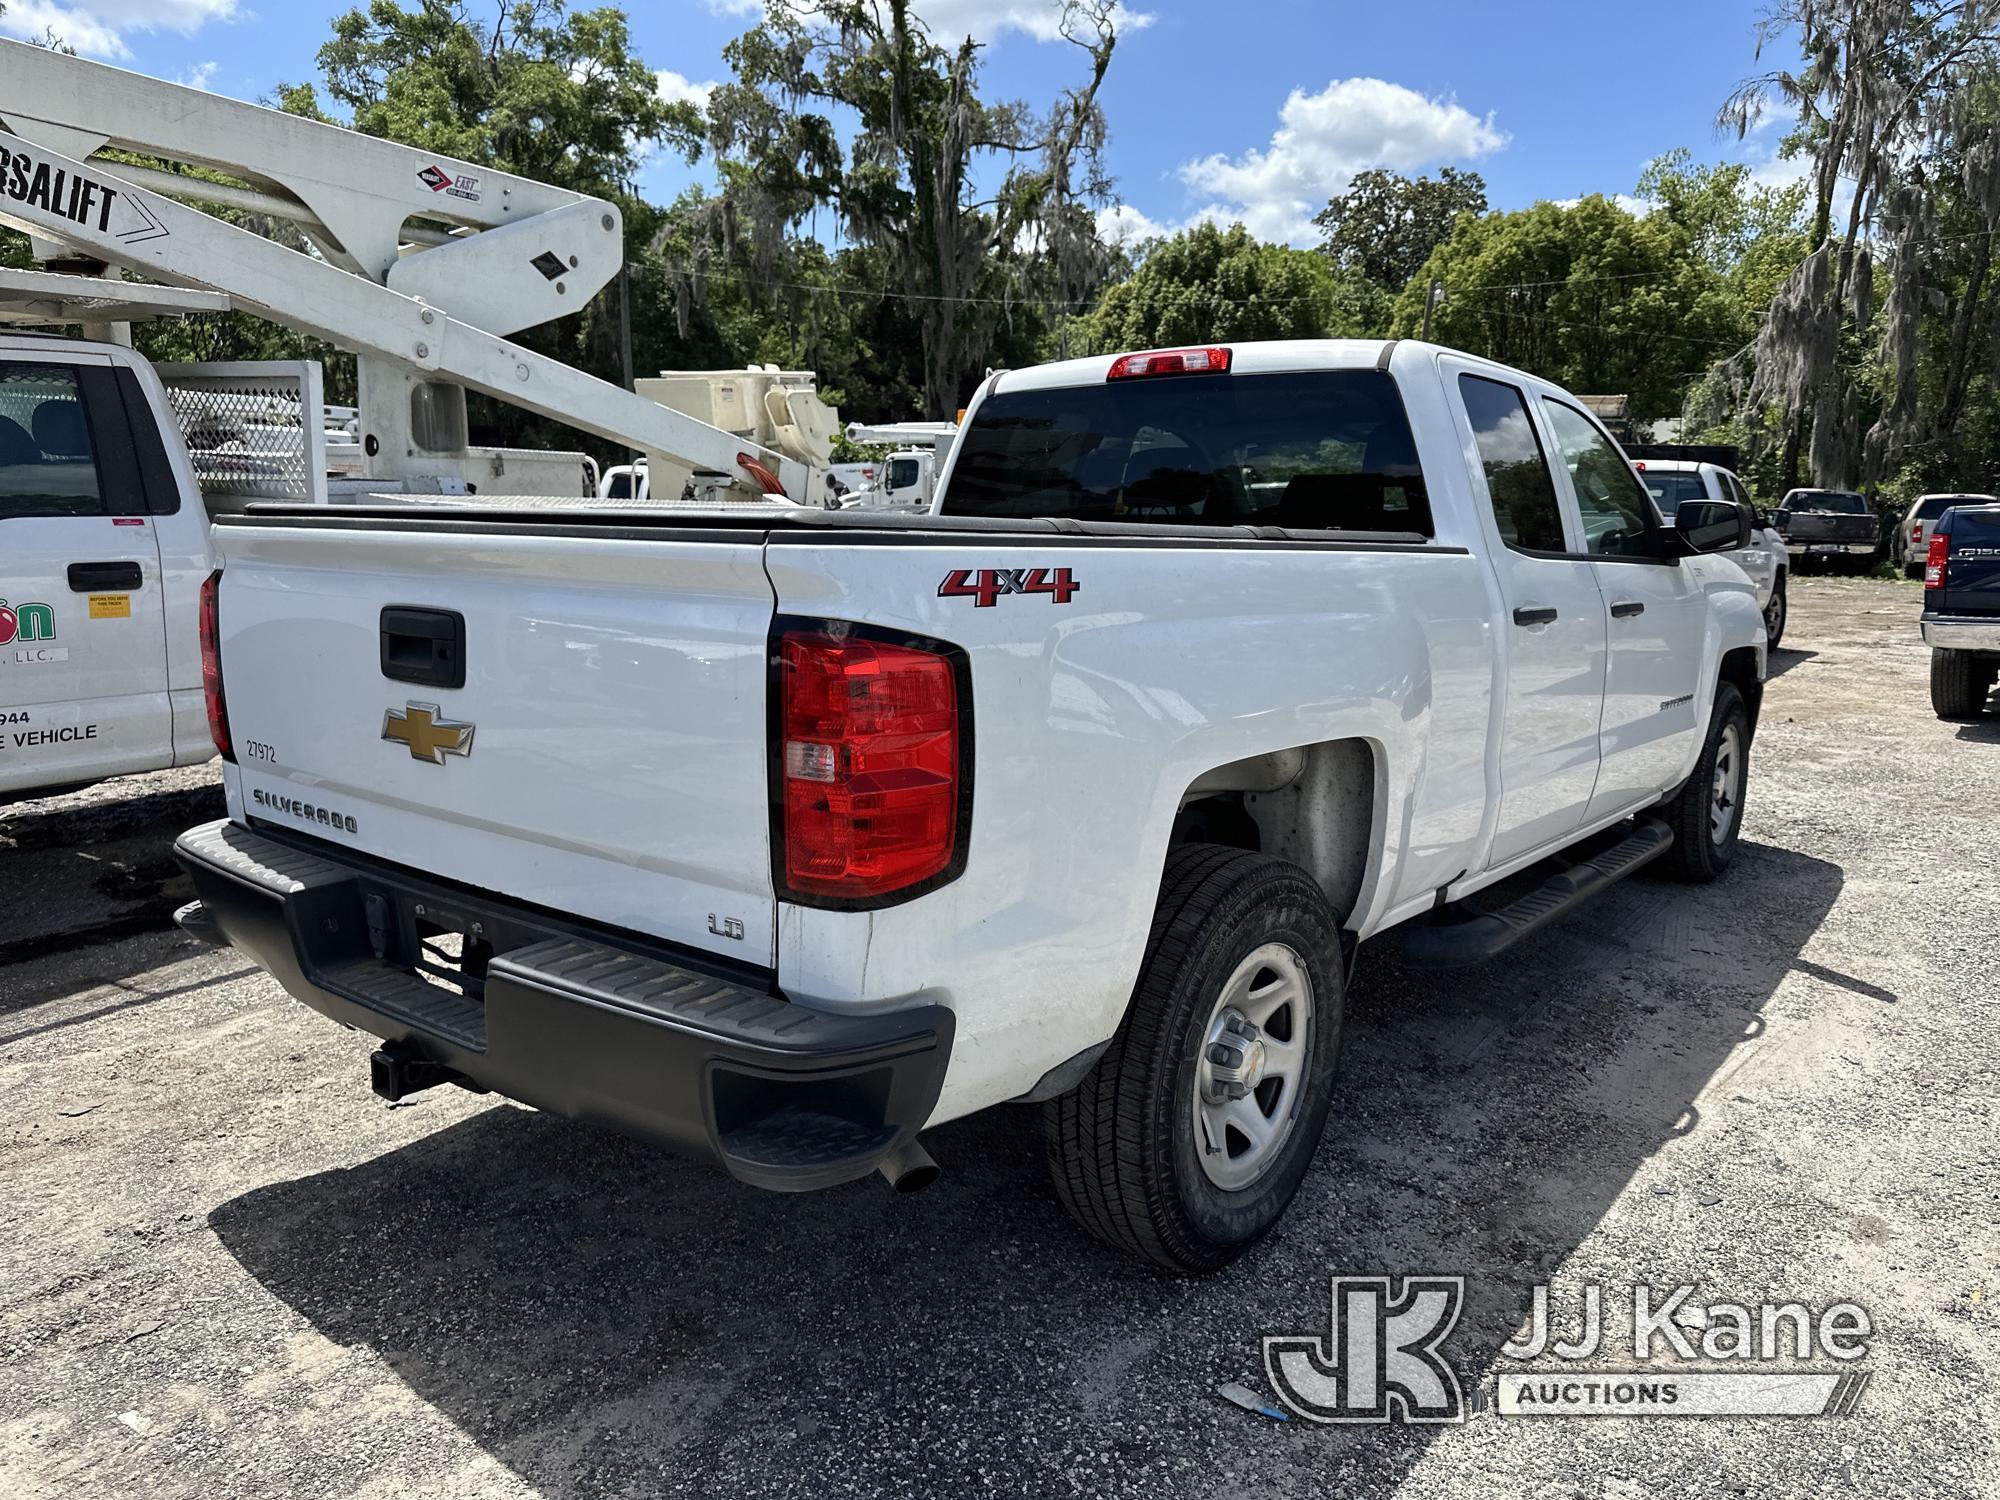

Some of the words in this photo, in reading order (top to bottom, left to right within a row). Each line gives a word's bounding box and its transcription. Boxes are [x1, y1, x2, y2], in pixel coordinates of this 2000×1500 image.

[13, 724, 97, 747] VEHICLE
[246, 740, 277, 763] 27972
[253, 788, 358, 834] SILVERADO
